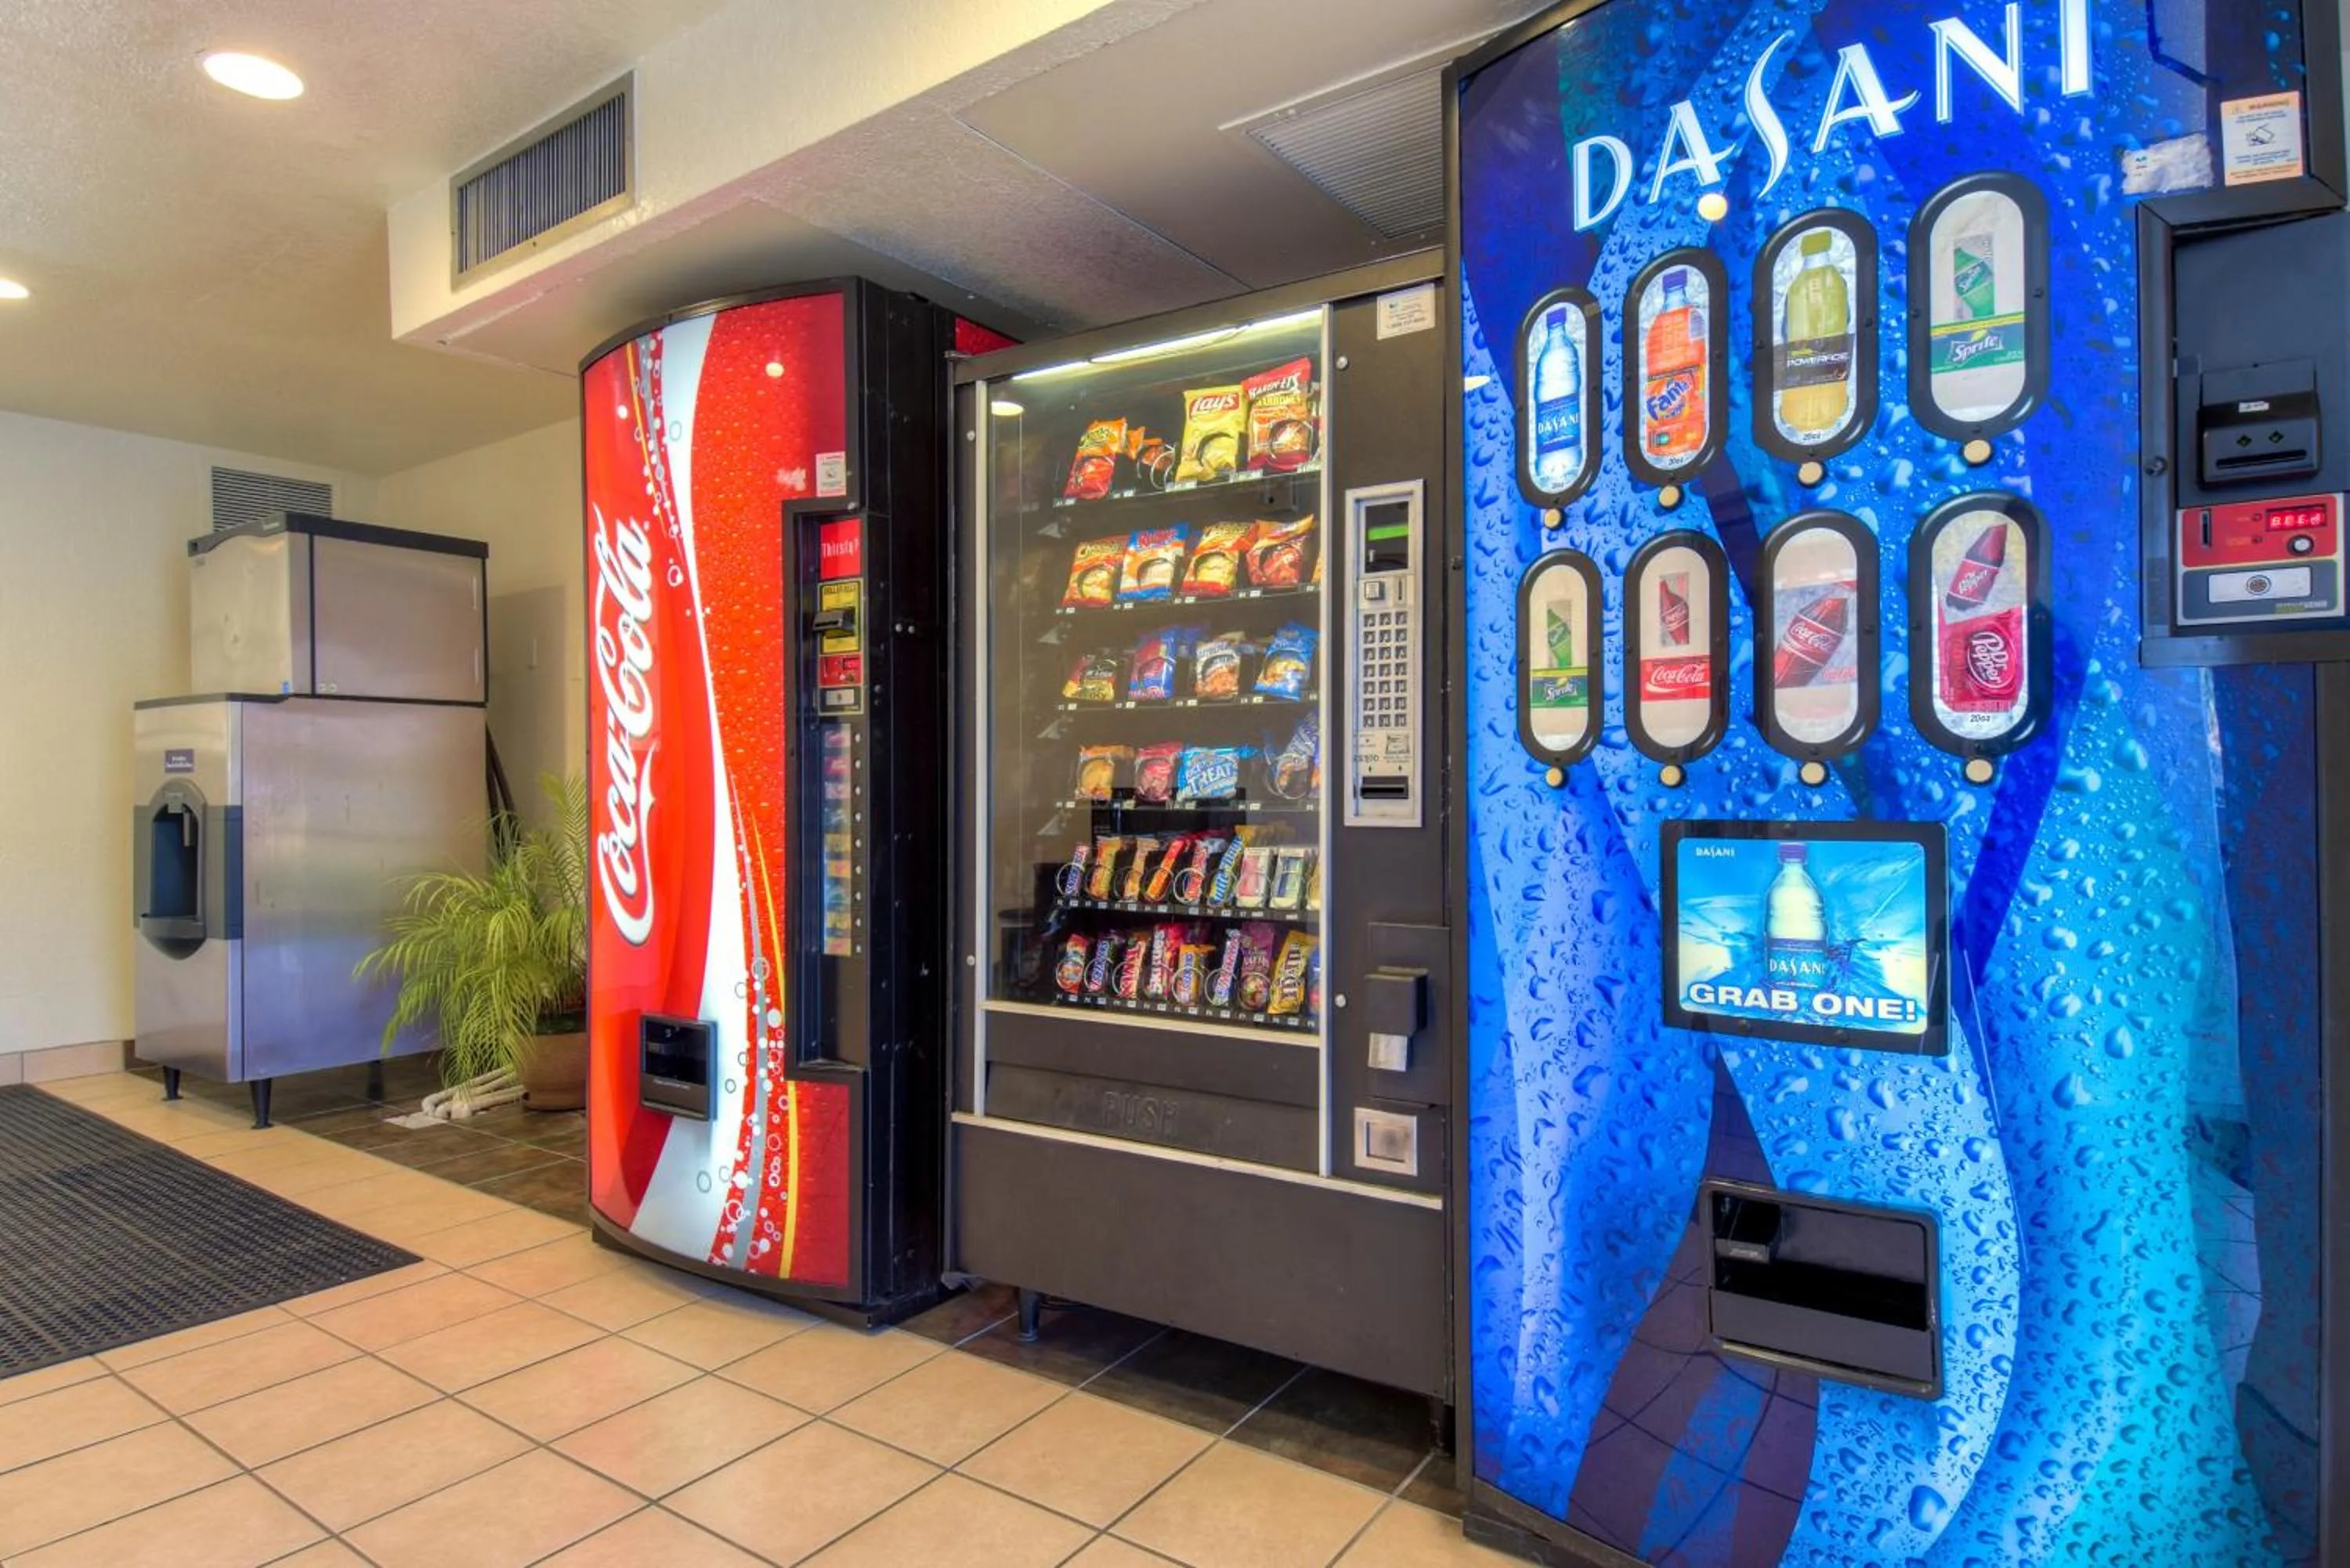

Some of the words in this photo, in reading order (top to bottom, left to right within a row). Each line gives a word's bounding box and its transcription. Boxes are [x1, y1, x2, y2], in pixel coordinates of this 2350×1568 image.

[1572, 0, 2092, 231] DASANI
[1953, 334, 1998, 363] Sprite
[1787, 352, 1849, 367] POWERADE
[1647, 379, 1689, 421] Fanta
[1538, 413, 1579, 434] DASANI
[821, 537, 859, 558] Thirsty?
[1971, 631, 2005, 684] Pepper
[1989, 650, 2009, 671] Dr
[1650, 663, 1705, 685] Coca-Cola
[1546, 681, 1574, 702] Sprite
[593, 501, 656, 946] Coca-Cola
[1695, 847, 1735, 858] DASANI
[1770, 957, 1825, 976] DASANI
[1689, 983, 1799, 1010] GRAB
[1812, 992, 1918, 1021] ONE!
